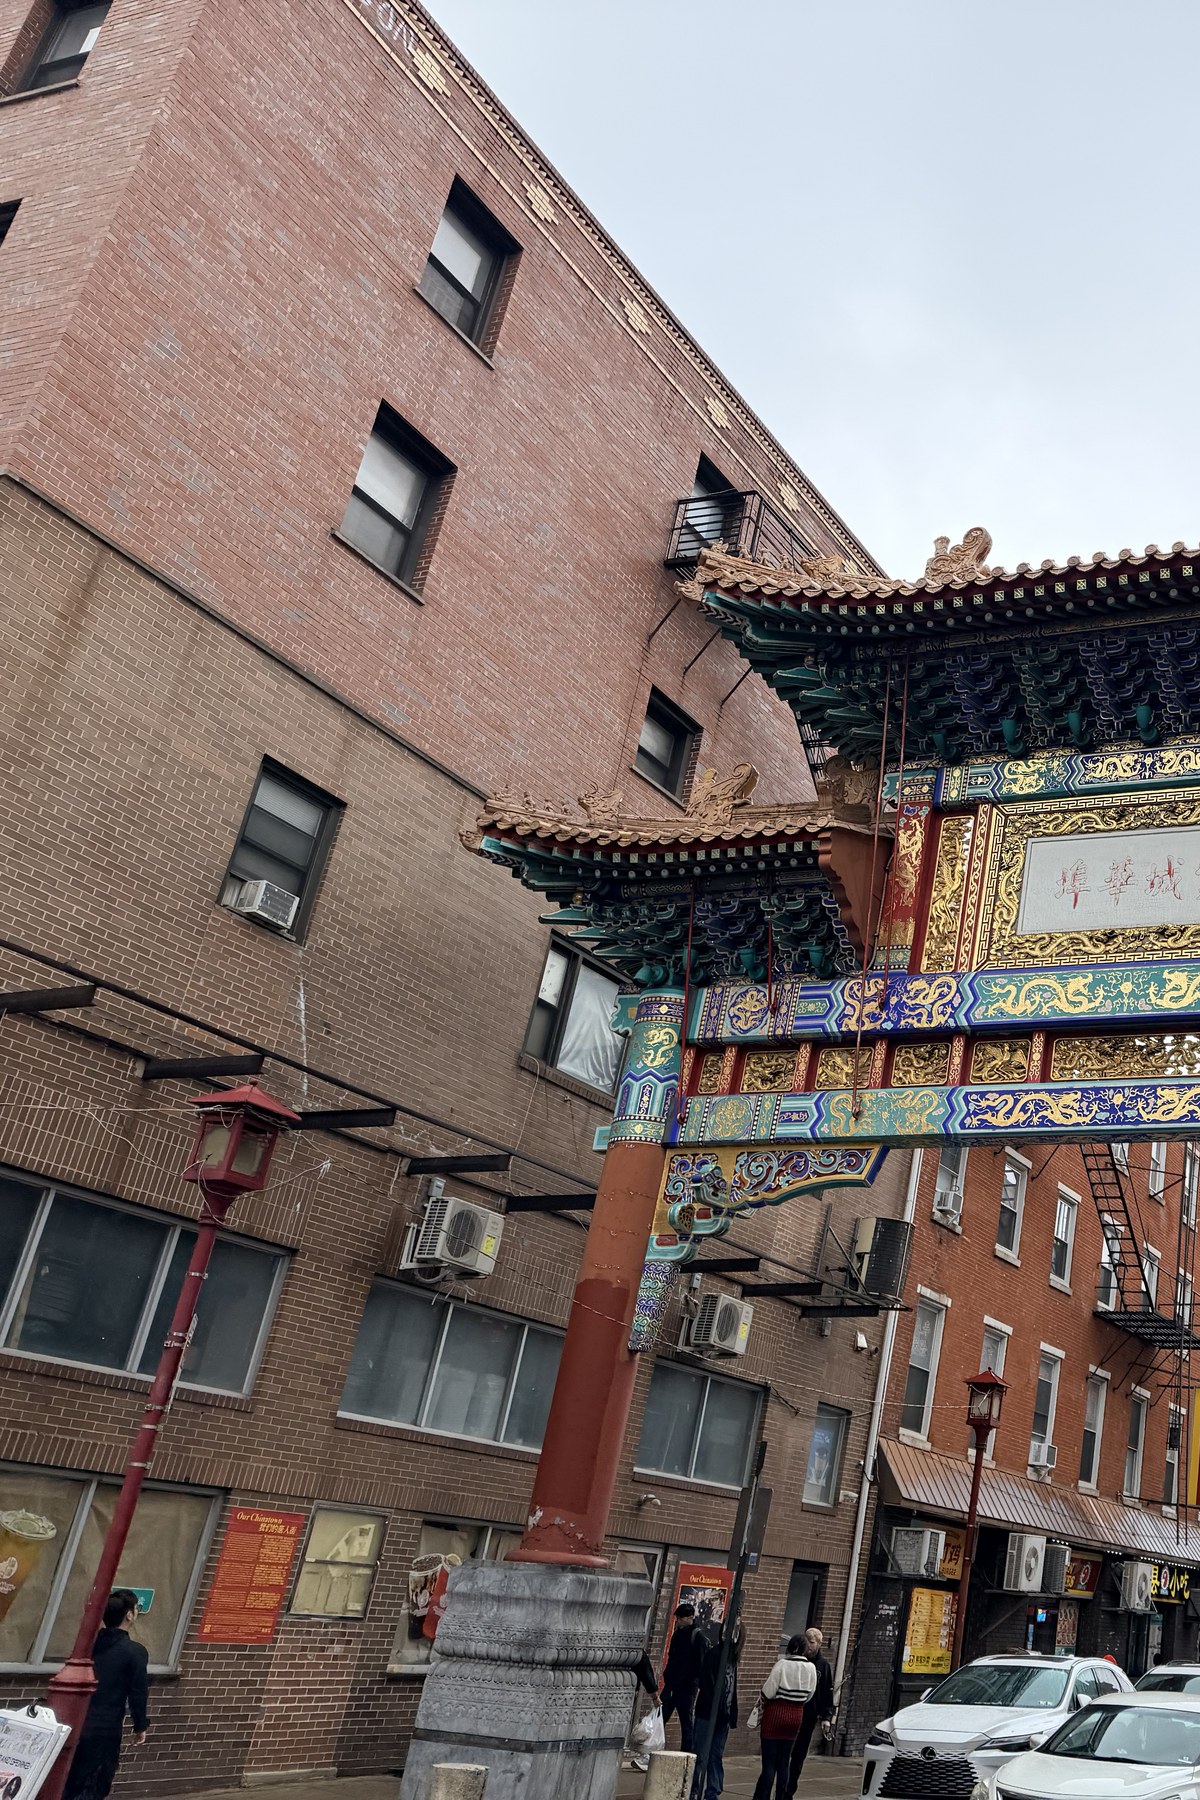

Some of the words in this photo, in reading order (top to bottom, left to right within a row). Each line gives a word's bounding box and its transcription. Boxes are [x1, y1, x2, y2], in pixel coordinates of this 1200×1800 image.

[237, 1511, 250, 1521] Our
[250, 1513, 283, 1524] Chinatown
[1169, 1568, 1191, 1600] 小吃
